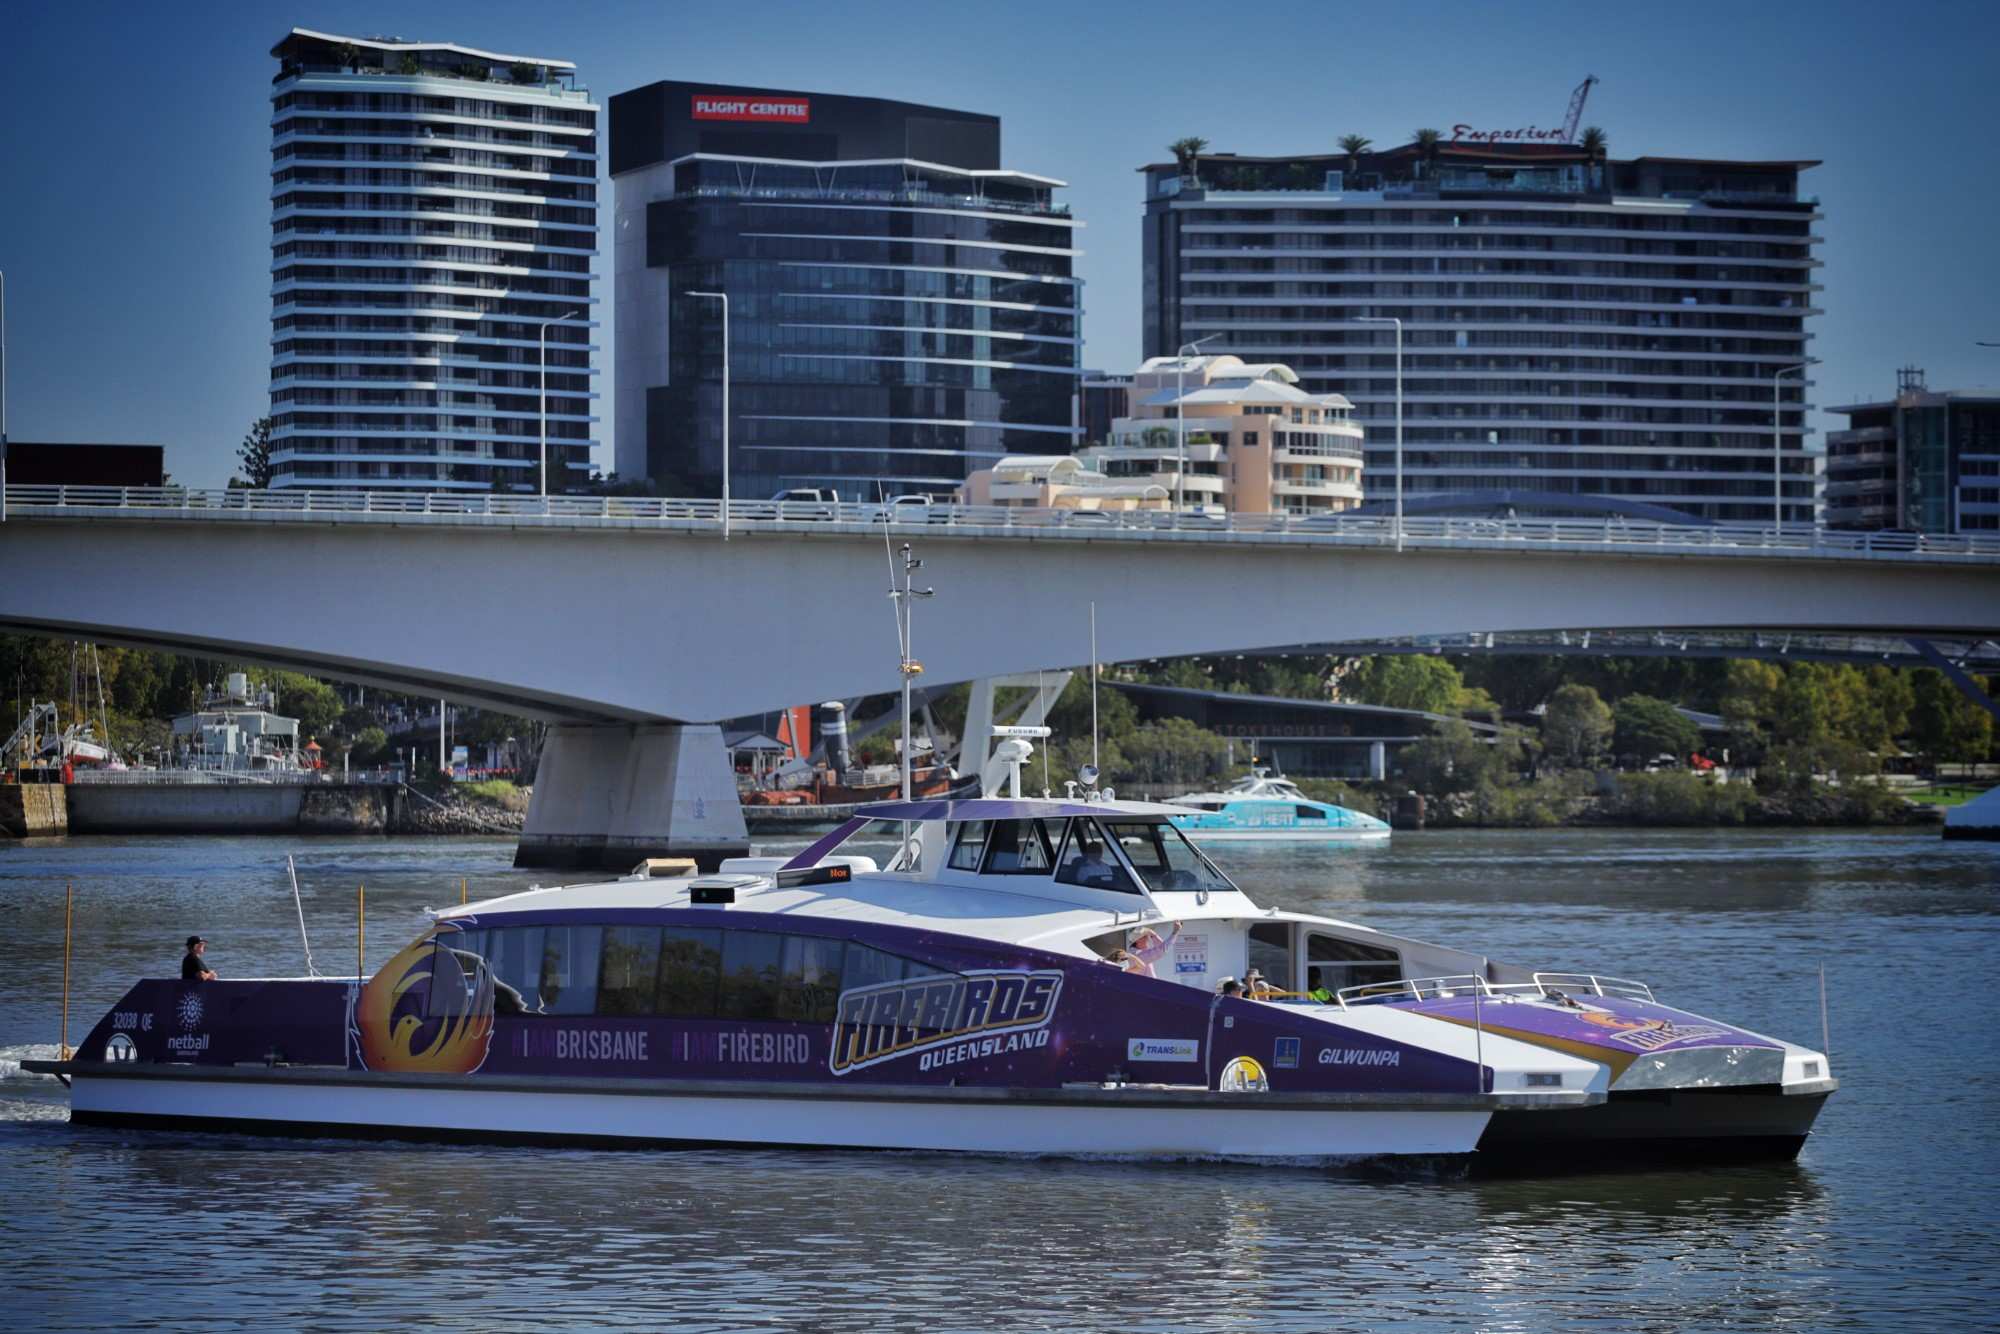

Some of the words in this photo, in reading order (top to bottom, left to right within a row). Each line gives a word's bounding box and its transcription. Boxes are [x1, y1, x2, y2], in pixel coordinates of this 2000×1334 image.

[696, 101, 747, 114] FLIGHT
[749, 103, 808, 116] CENTRE
[1450, 124, 1566, 152] Emporium
[833, 973, 1061, 1071] FIREBIRDS
[167, 1033, 210, 1050] netball
[920, 1029, 1050, 1071] QUEENSLAND
[1318, 1047, 1400, 1067] GILWUNPA
